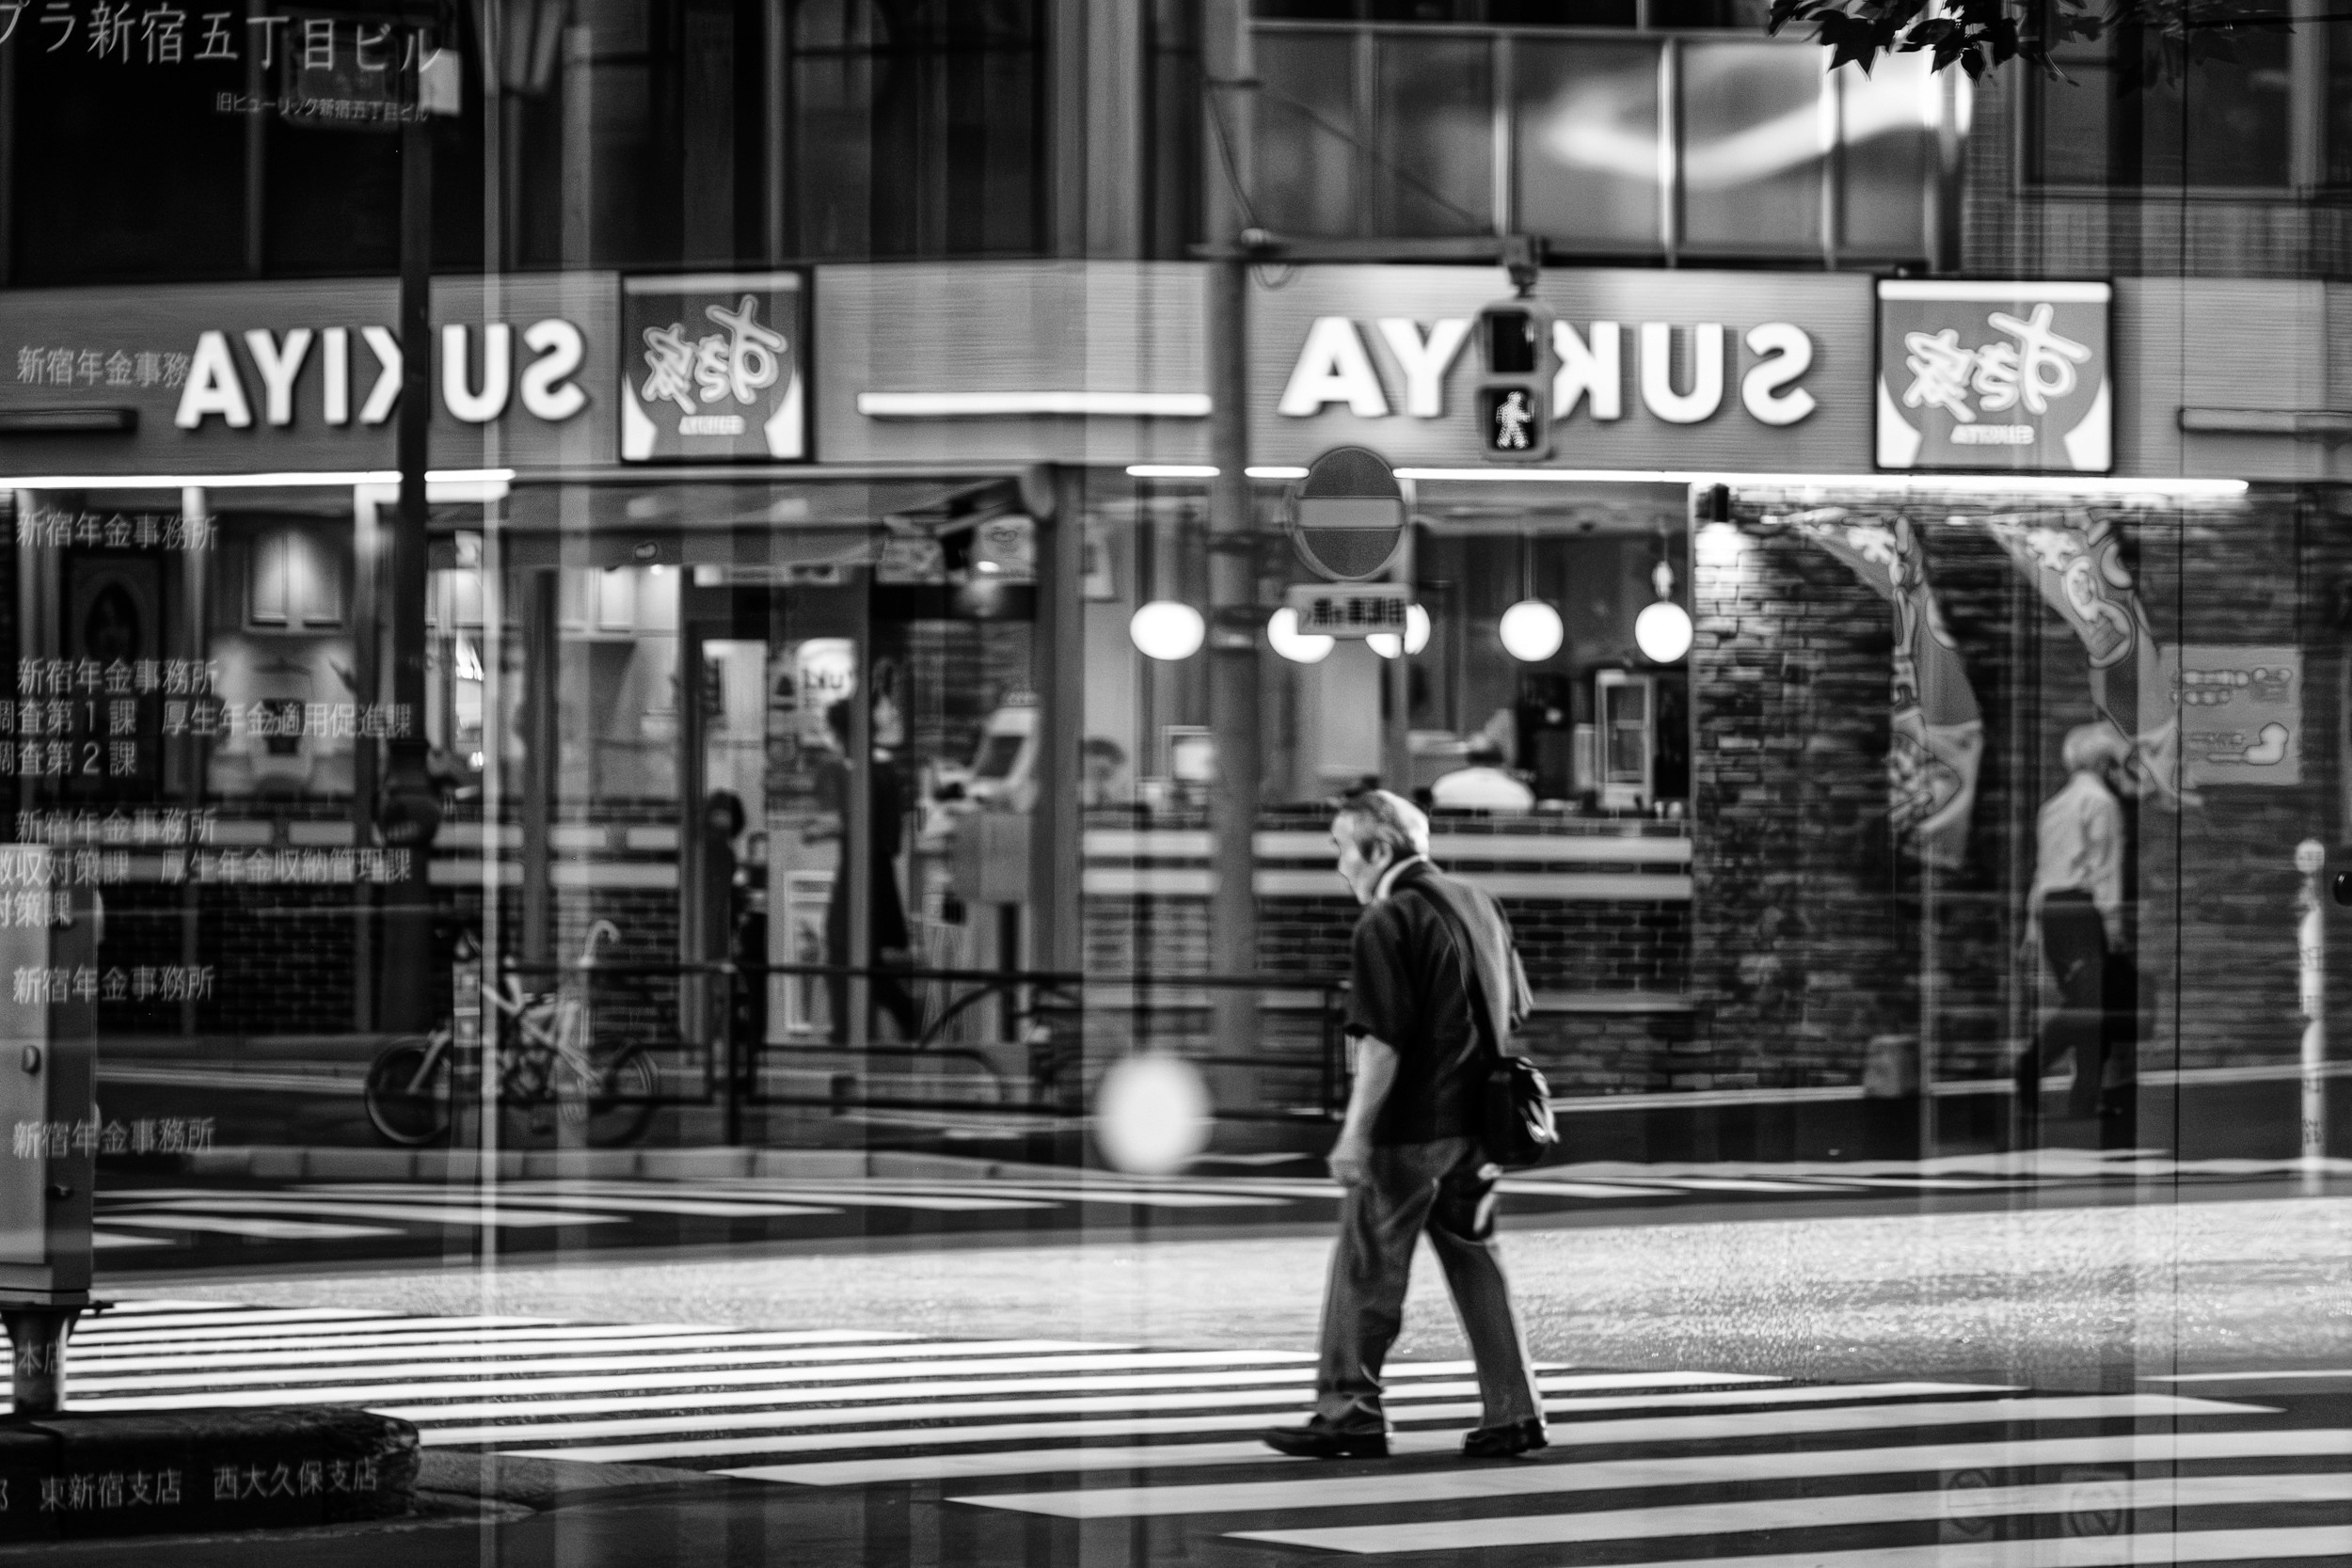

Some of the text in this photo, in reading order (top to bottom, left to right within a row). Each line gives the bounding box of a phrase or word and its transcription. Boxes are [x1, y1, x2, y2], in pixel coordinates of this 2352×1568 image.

[17, 345, 192, 388] 新宿年金事務
[16, 510, 218, 549] 新宿年金事務所
[17, 657, 218, 695] 新宿年金事務所
[162, 699, 411, 737] 厚生年金適用促進課
[16, 807, 217, 844] 新宿年金事務所
[13, 964, 215, 1005] 新宿年金事務所
[13, 1117, 215, 1159] 新宿年金事務所
[40, 1468, 183, 1513] 東新宿支店
[213, 1457, 380, 1502] 西大久保支店
